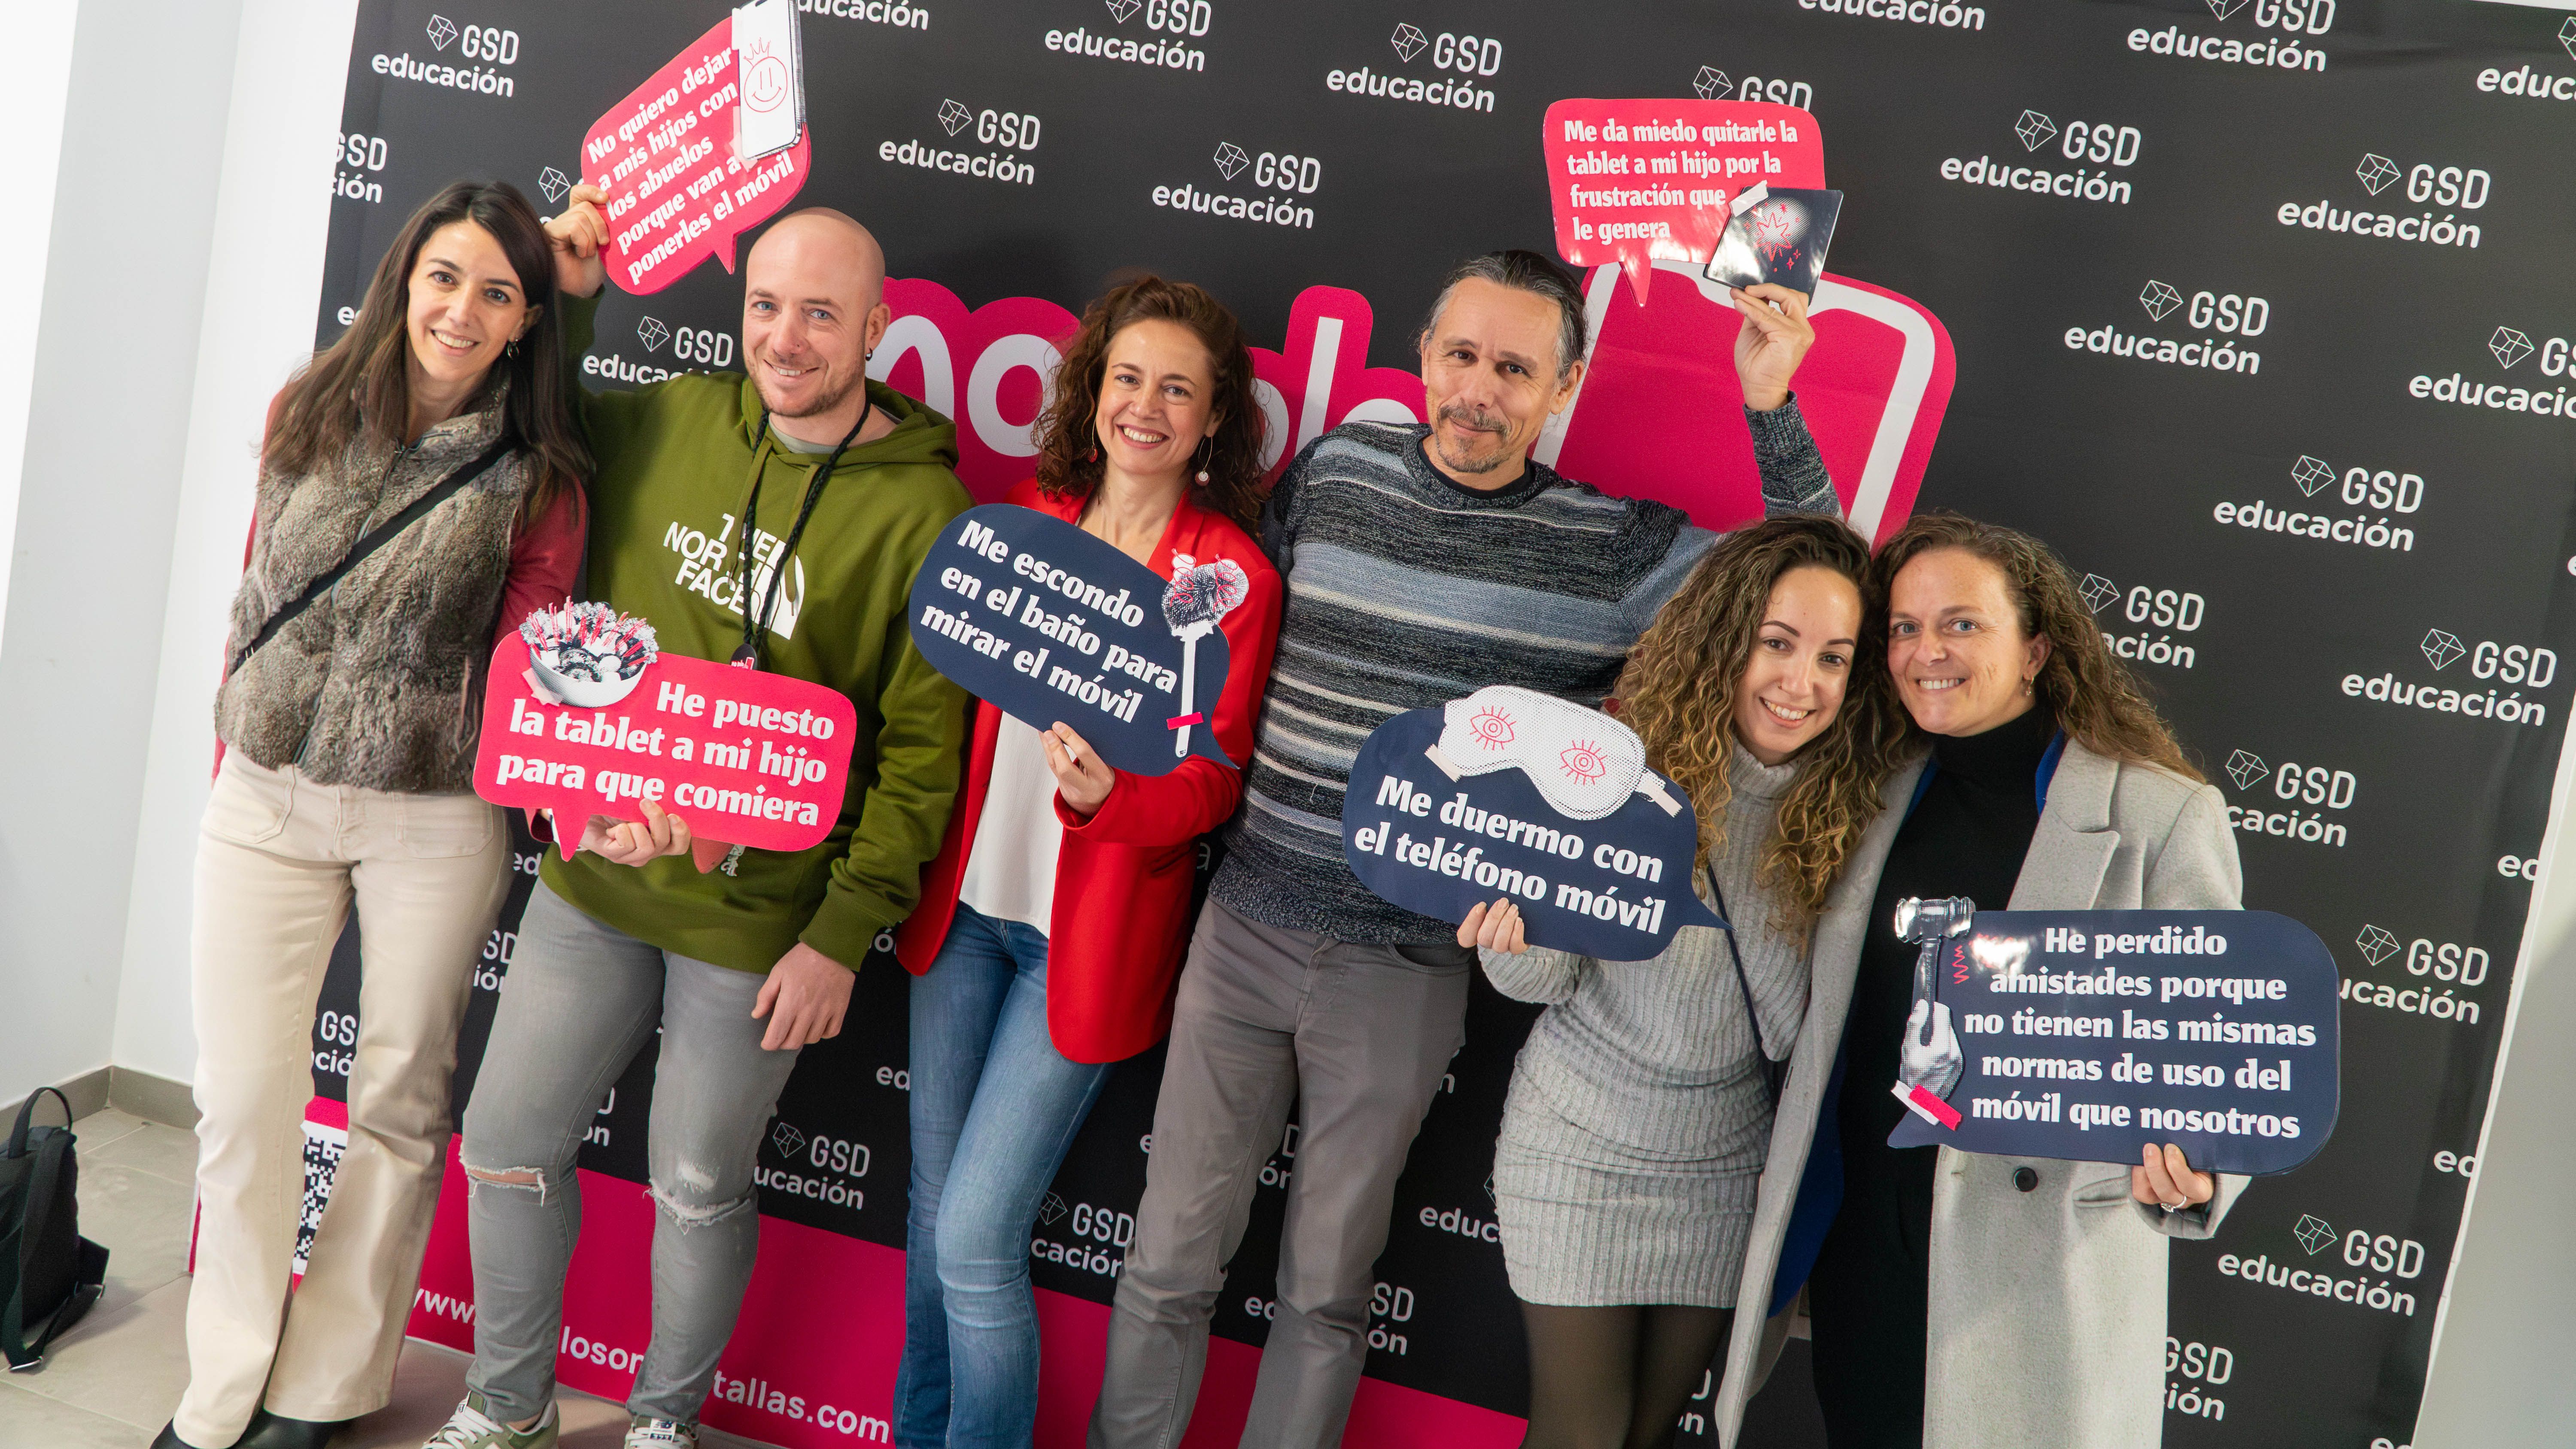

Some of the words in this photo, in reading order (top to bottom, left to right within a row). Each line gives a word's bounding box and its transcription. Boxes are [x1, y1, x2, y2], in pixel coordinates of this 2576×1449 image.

[1147, 0, 1211, 36] GSD
[2255, 0, 2335, 34] GSD
[462, 25, 519, 64] GSD
[1045, 27, 1204, 71] educación
[1434, 33, 1502, 76] GSD
[2128, 26, 2326, 72] educación
[372, 53, 513, 97] educación
[1327, 67, 1494, 112] educación
[587, 135, 616, 164] No
[619, 88, 678, 142] quiero
[682, 47, 731, 94] dejar
[598, 174, 612, 193] a
[613, 147, 648, 182] mis
[647, 111, 697, 155] hijos
[700, 83, 738, 117] con
[978, 109, 1040, 150] GSD
[1565, 121, 1597, 141] Me
[1603, 118, 1628, 141] da
[1633, 119, 1697, 142] miedo
[1702, 120, 1776, 146] quitarle
[1779, 120, 1797, 142] la
[2063, 121, 2141, 166] GSD
[607, 191, 636, 221] los
[638, 136, 713, 199] abuelos
[879, 139, 1034, 185] educación
[1255, 152, 1321, 193] GSD
[1567, 151, 1629, 174] tablet
[1634, 158, 1646, 173] a
[1651, 151, 1677, 173] mi
[1681, 151, 1720, 179] hijo
[1725, 158, 1759, 178] por
[1763, 151, 1781, 173] la
[1941, 155, 2130, 204] educación
[617, 194, 685, 255] porque
[686, 167, 725, 200] van
[726, 155, 741, 175] a
[1152, 184, 1313, 228] educación
[1571, 183, 1684, 207] frustración
[1690, 189, 1725, 210] que
[2407, 164, 2490, 209] GSD
[628, 213, 711, 285] ponerles
[714, 190, 734, 220] el
[735, 150, 794, 206] móvil
[1573, 217, 1592, 239] le
[1599, 221, 1670, 245] genera
[2278, 200, 2480, 248] educación
[2189, 291, 2269, 336] GSD
[675, 327, 733, 367] GSD
[2065, 325, 2260, 374] educación
[2409, 373, 2576, 419] educaci
[2342, 467, 2424, 513] GSD
[718, 513, 777, 562] TE
[2214, 500, 2413, 551] educación
[675, 558, 744, 615] FACE
[957, 520, 1008, 563] Me
[1014, 554, 1143, 627] escondo
[941, 567, 981, 600] en
[986, 586, 1022, 617] el
[1020, 594, 1100, 655] baño
[1102, 645, 1177, 693] para
[2126, 586, 2204, 631] GSD
[921, 606, 1011, 660] mirar
[1014, 648, 1049, 678] el
[1047, 666, 1143, 723] móvil
[2472, 641, 2557, 688] GSD
[657, 682, 705, 716] He
[713, 700, 834, 739] puesto
[2342, 673, 2545, 726] educación
[510, 699, 544, 736] la
[556, 712, 665, 755] tablet
[672, 737, 693, 761] a
[703, 738, 750, 770] mi
[759, 742, 826, 786] hijo
[496, 755, 585, 789] para
[595, 771, 664, 802] que
[674, 783, 818, 825] comiera
[2275, 763, 2356, 809] GSD
[1376, 776, 1431, 816] Me
[1440, 793, 1583, 859] duermo
[1594, 844, 1662, 882] con
[1355, 822, 1391, 855] el
[1396, 833, 1546, 900] teléfono
[1555, 885, 1665, 934] móvil
[2046, 928, 2085, 953] He
[2095, 926, 2227, 959] perdido
[2407, 939, 2489, 986] GSD
[1990, 966, 2151, 996] amistades
[2161, 977, 2286, 1004] porque
[1965, 1014, 2003, 1034] no
[2012, 1007, 2112, 1037] tienen
[2123, 1009, 2169, 1040] las
[2178, 1012, 2316, 1046] mismas
[1982, 1057, 2102, 1080] normas
[2111, 1053, 2152, 1083] de
[2163, 1064, 2224, 1087] uso
[2235, 1058, 2290, 1091] del
[1972, 1091, 2060, 1122] móvil
[2070, 1104, 2130, 1131] que
[2140, 1108, 2300, 1138] nosotros
[811, 1136, 869, 1176] GSD
[1073, 1203, 1134, 1247] GSD
[2344, 1230, 2424, 1278] GSD
[2218, 1255, 2415, 1316] educación
